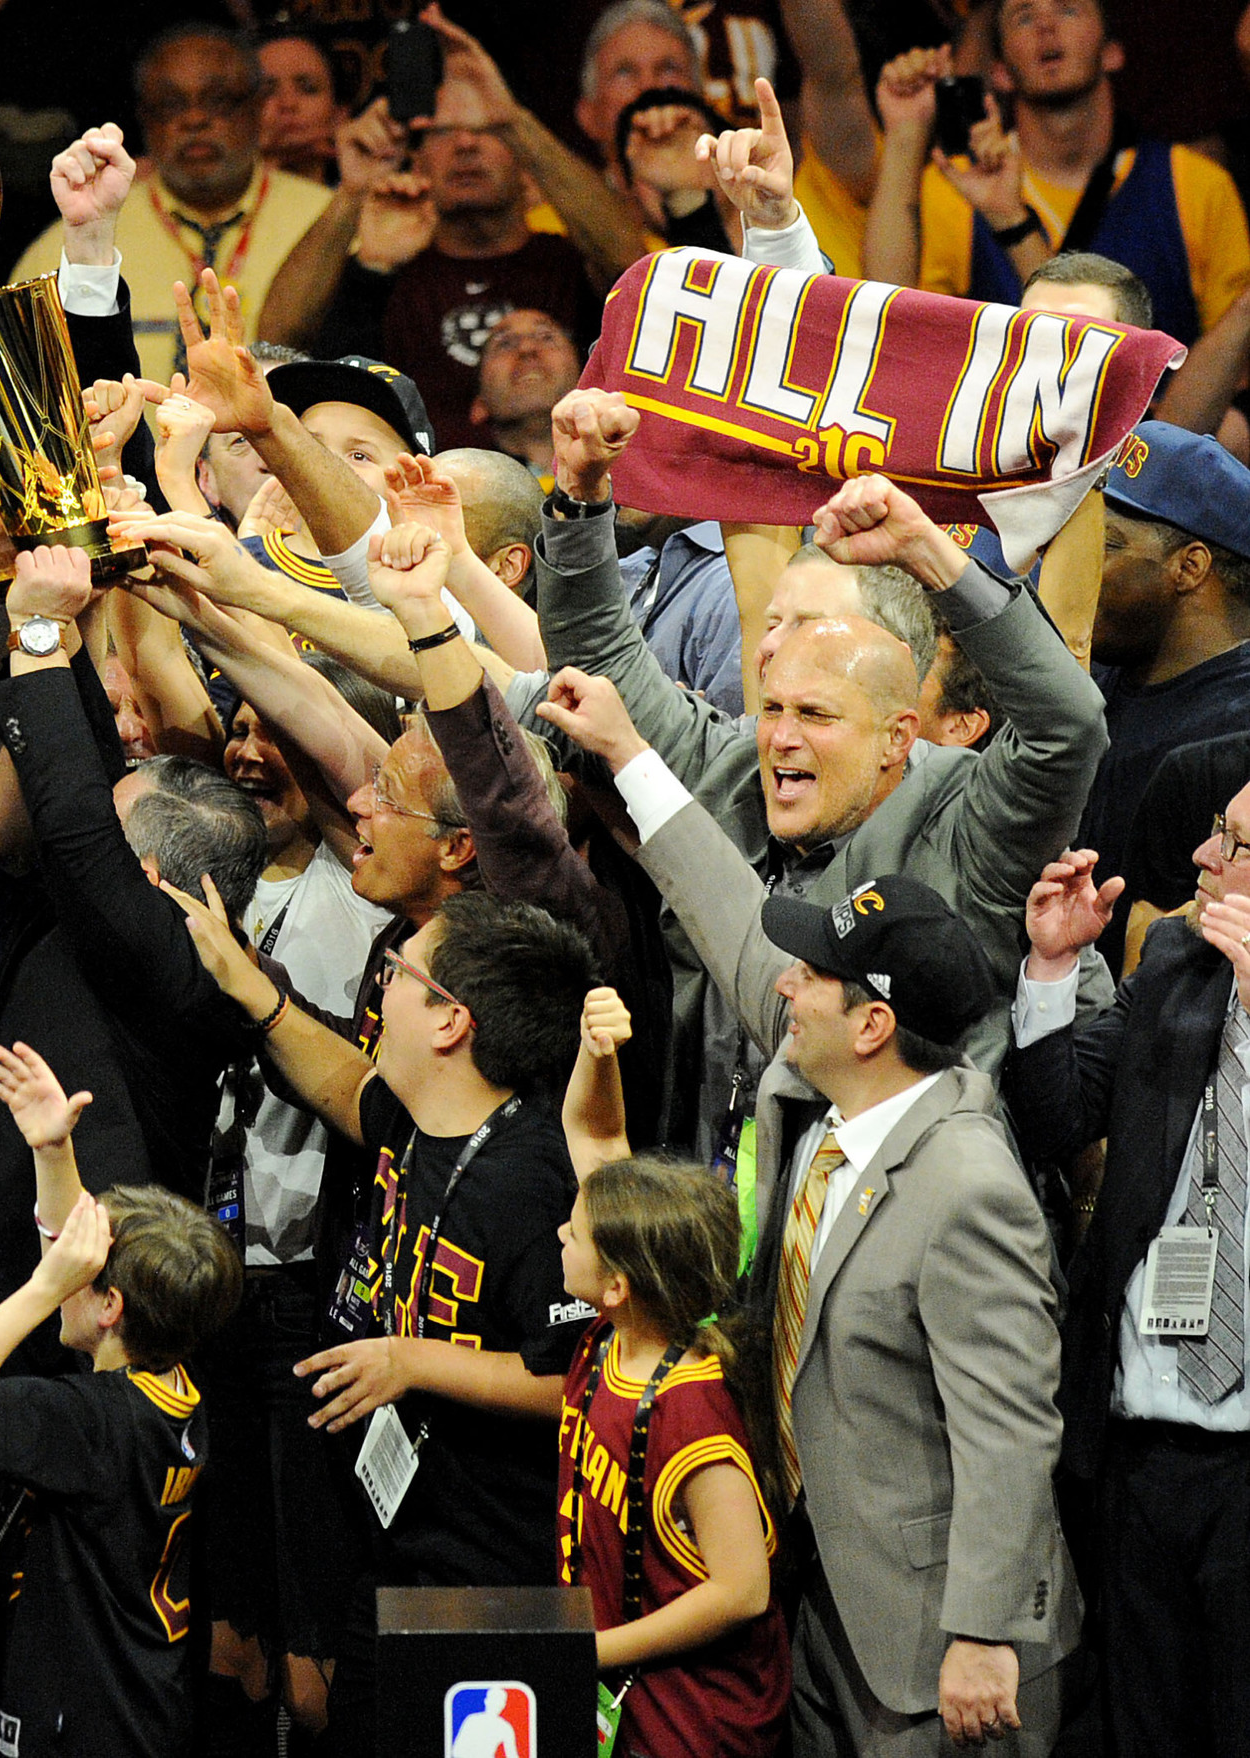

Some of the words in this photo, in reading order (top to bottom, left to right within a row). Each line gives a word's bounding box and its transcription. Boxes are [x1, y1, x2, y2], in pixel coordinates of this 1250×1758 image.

[625, 247, 897, 457] ALL
[936, 302, 1127, 482] IN
[263, 928, 280, 952] 2016
[1204, 1085, 1214, 1111] 2016
[469, 1123, 491, 1148] 2016
[384, 1262, 393, 1288] 2016
